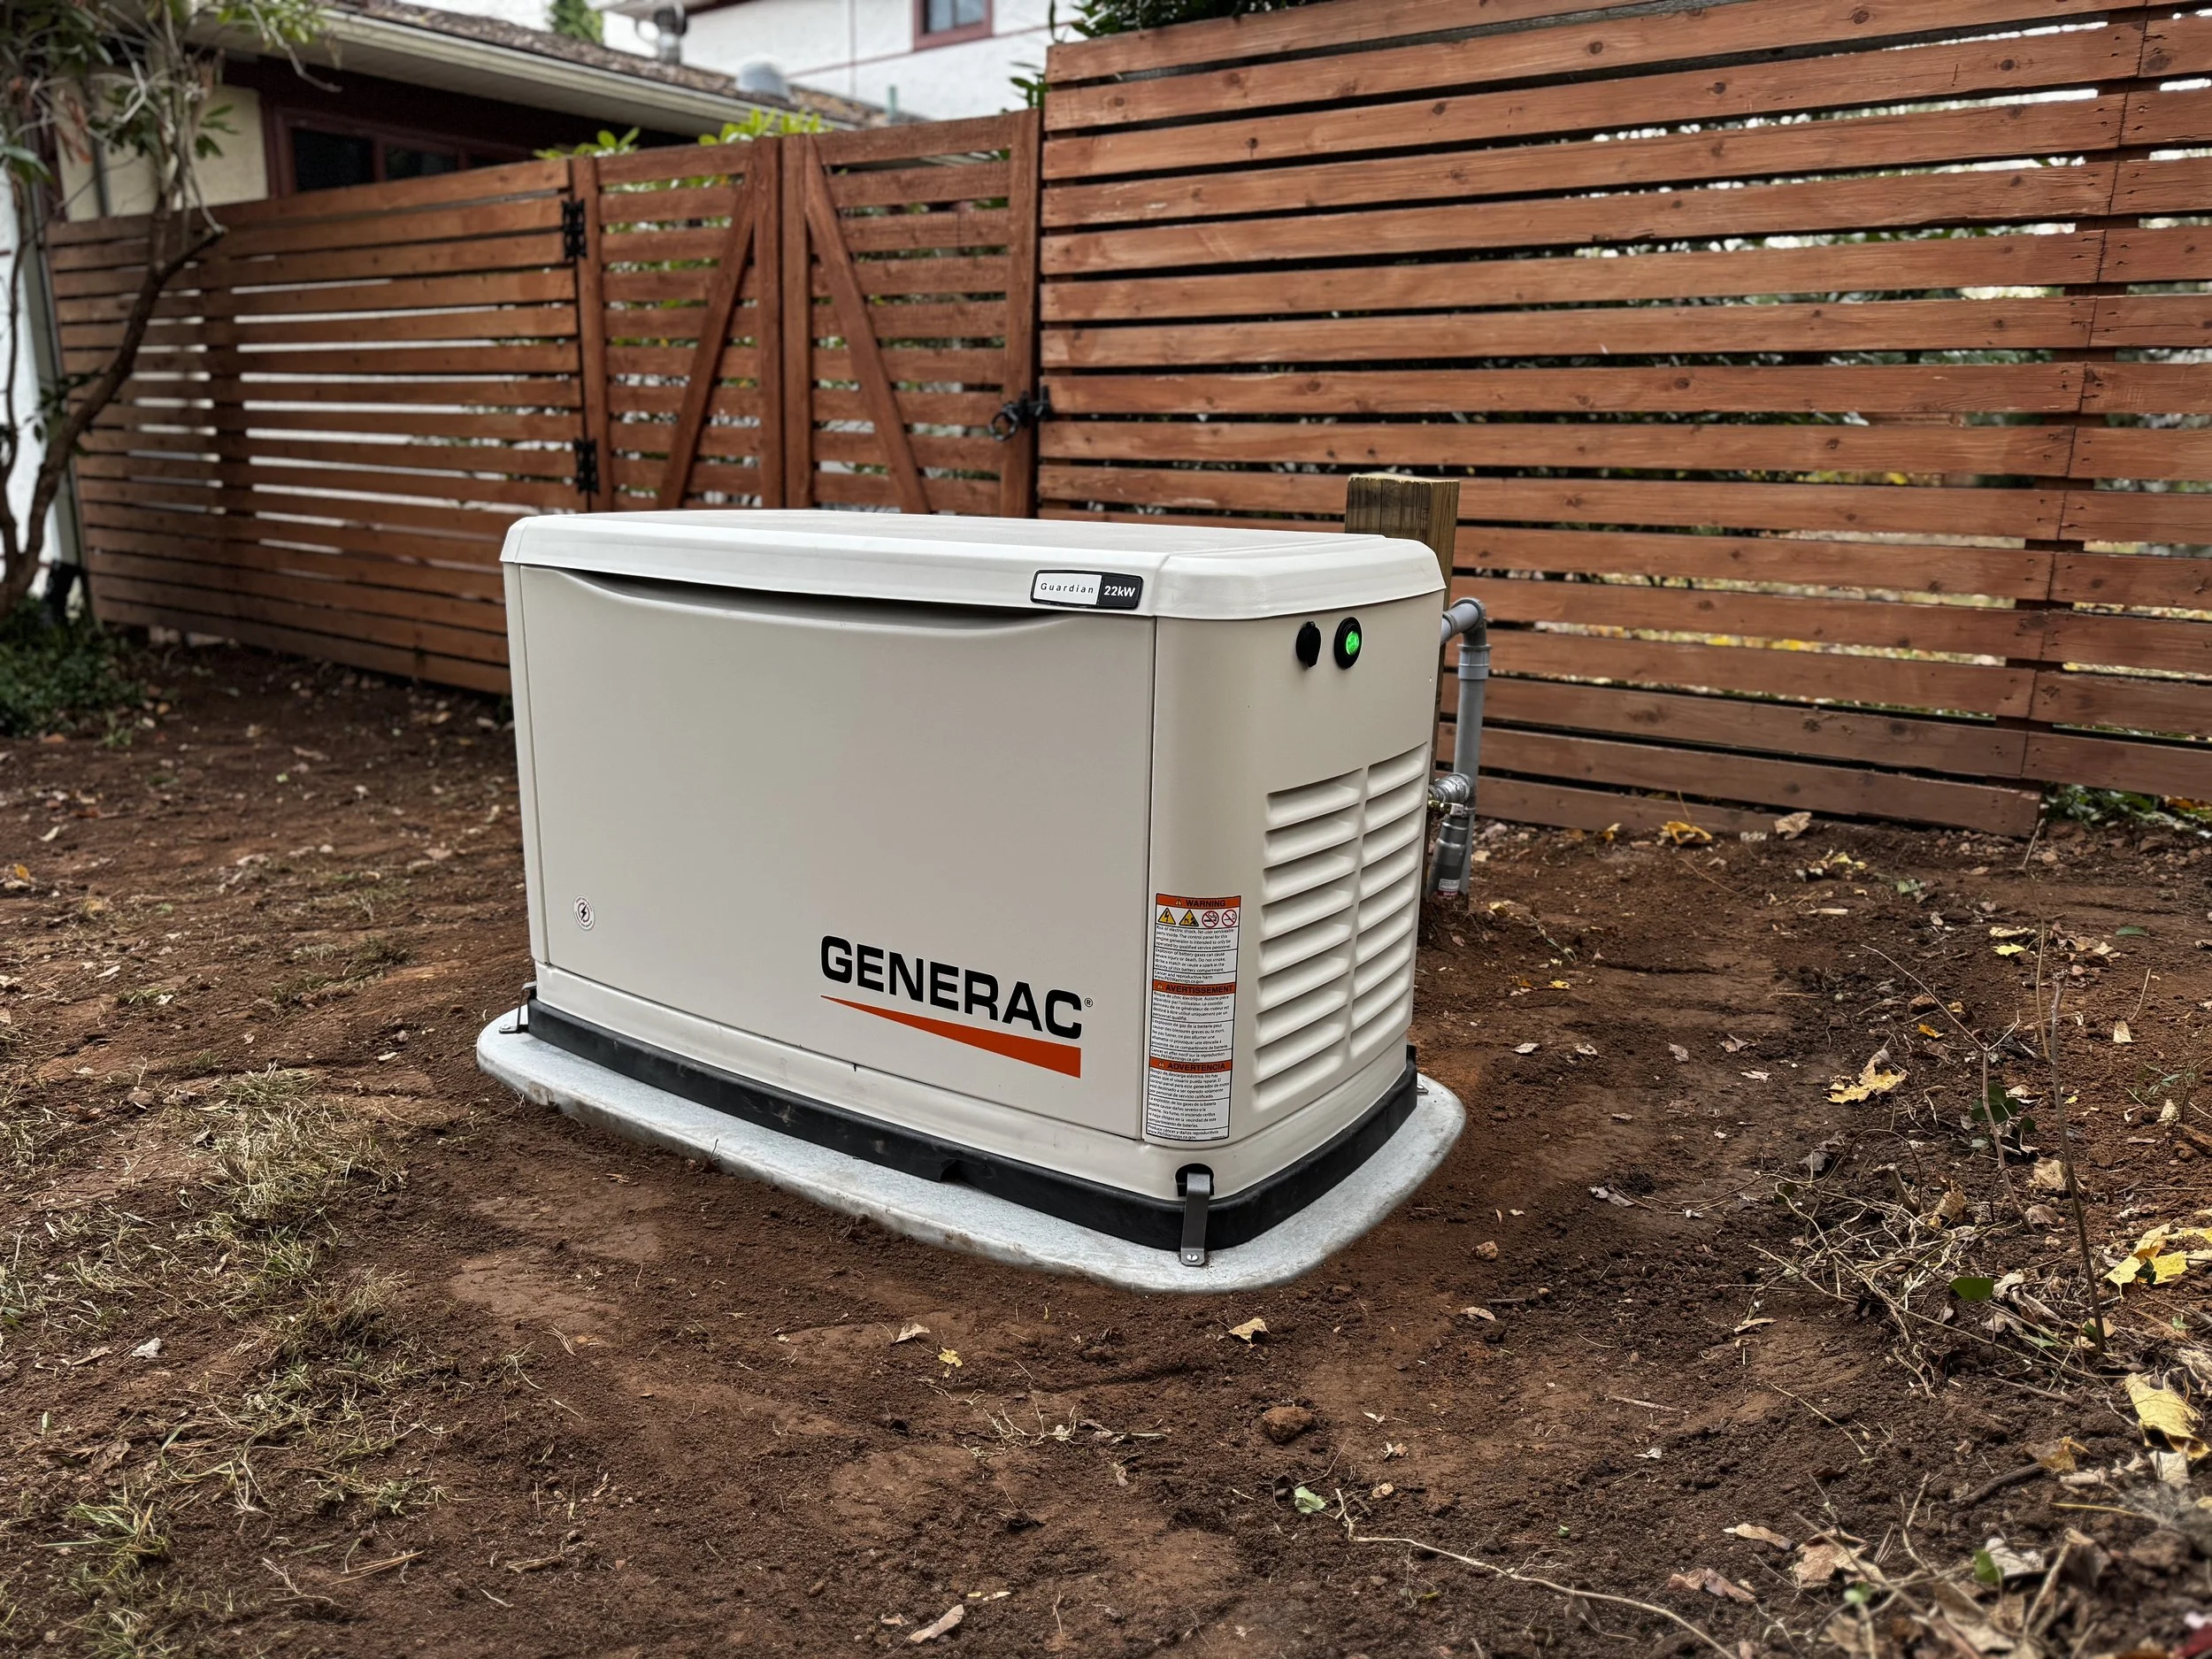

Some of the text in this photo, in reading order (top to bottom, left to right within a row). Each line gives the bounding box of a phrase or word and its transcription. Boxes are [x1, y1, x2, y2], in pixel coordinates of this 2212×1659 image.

[1041, 582, 1135, 597] Guardian 22kW
[821, 935, 1082, 1039] GENERAC
[1165, 984, 1233, 994] AVERTISSEMENT
